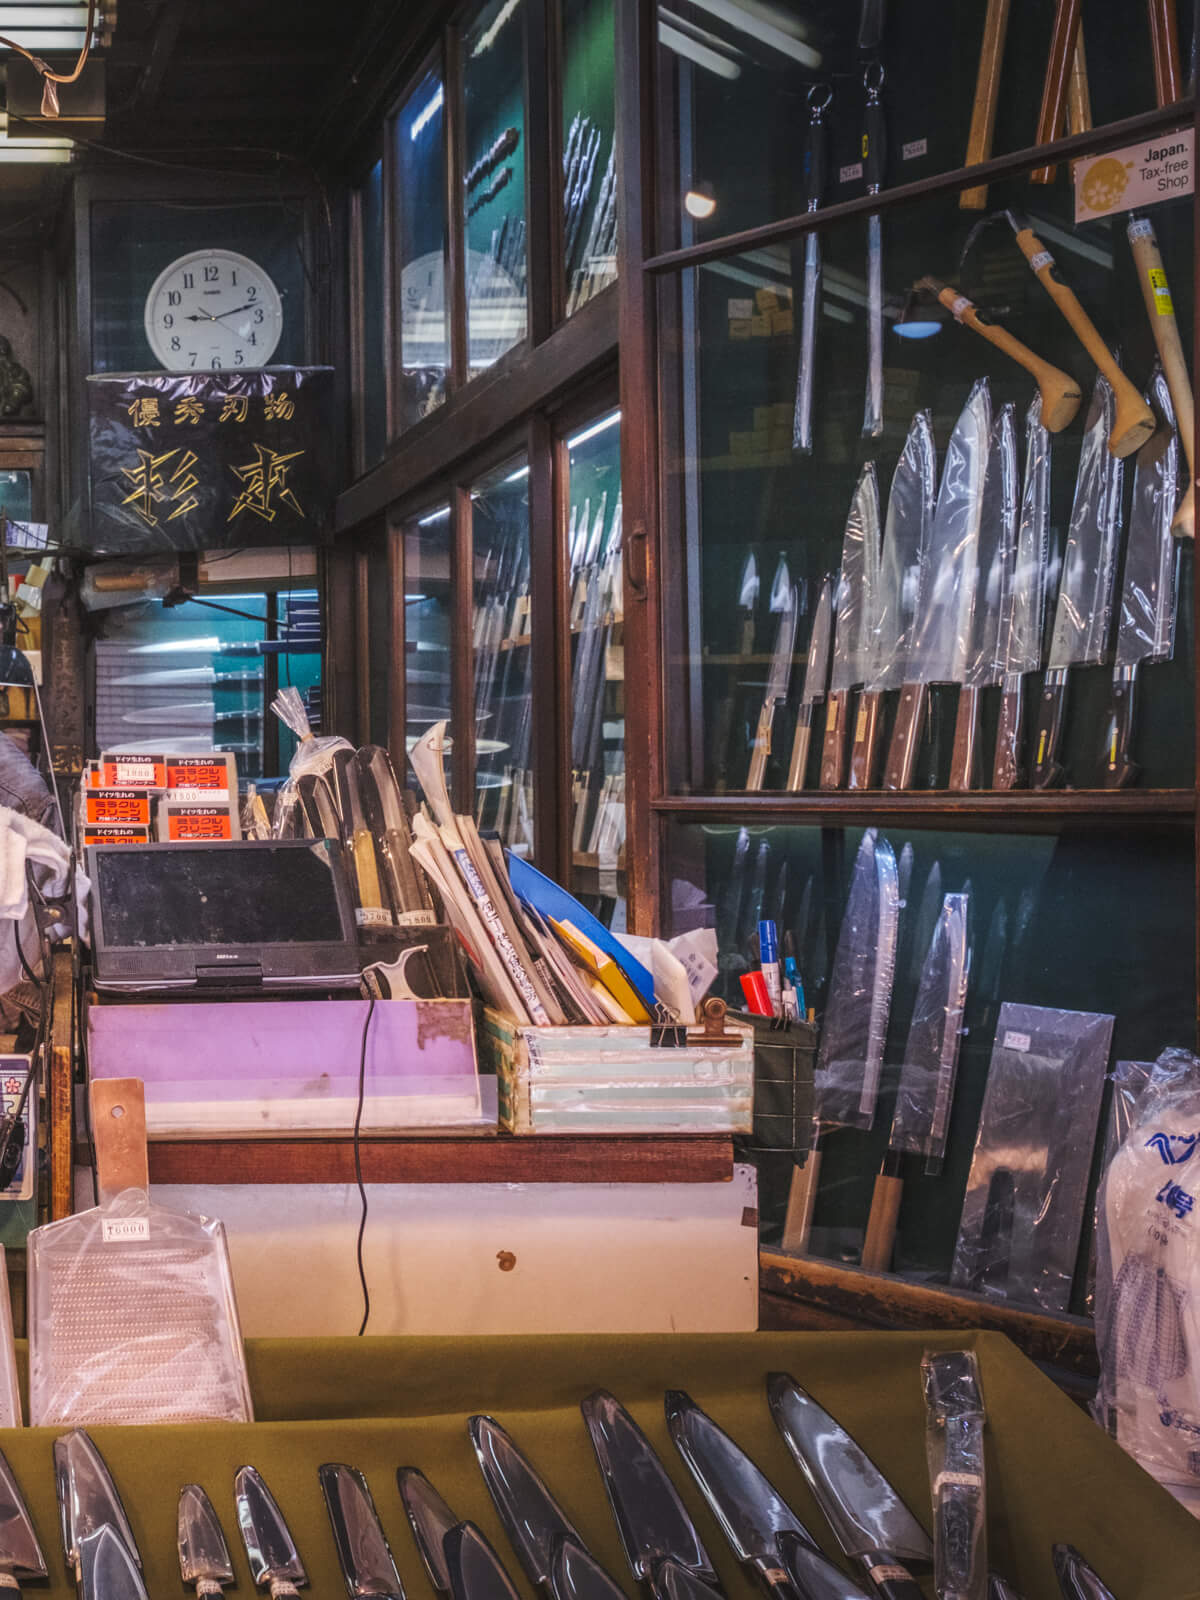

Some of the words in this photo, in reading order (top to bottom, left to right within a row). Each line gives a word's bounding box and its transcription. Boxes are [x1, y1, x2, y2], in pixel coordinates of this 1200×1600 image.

[1144, 143, 1189, 163] Japan.
[1139, 159, 1189, 181] Tax-free
[1157, 175, 1189, 192] Shop
[183, 273, 194, 289] 11
[204, 266, 219, 282] 12
[232, 271, 237, 287] 1
[168, 290, 182, 306] 10
[247, 286, 257, 301] 2
[163, 314, 174, 329] 9
[254, 309, 264, 324] 3
[171, 336, 181, 351] 8
[248, 332, 257, 346] 4
[189, 353, 198, 367] 7
[211, 356, 222, 370] 6
[234, 350, 244, 365] 5
[128, 391, 296, 428] 優秀刃物
